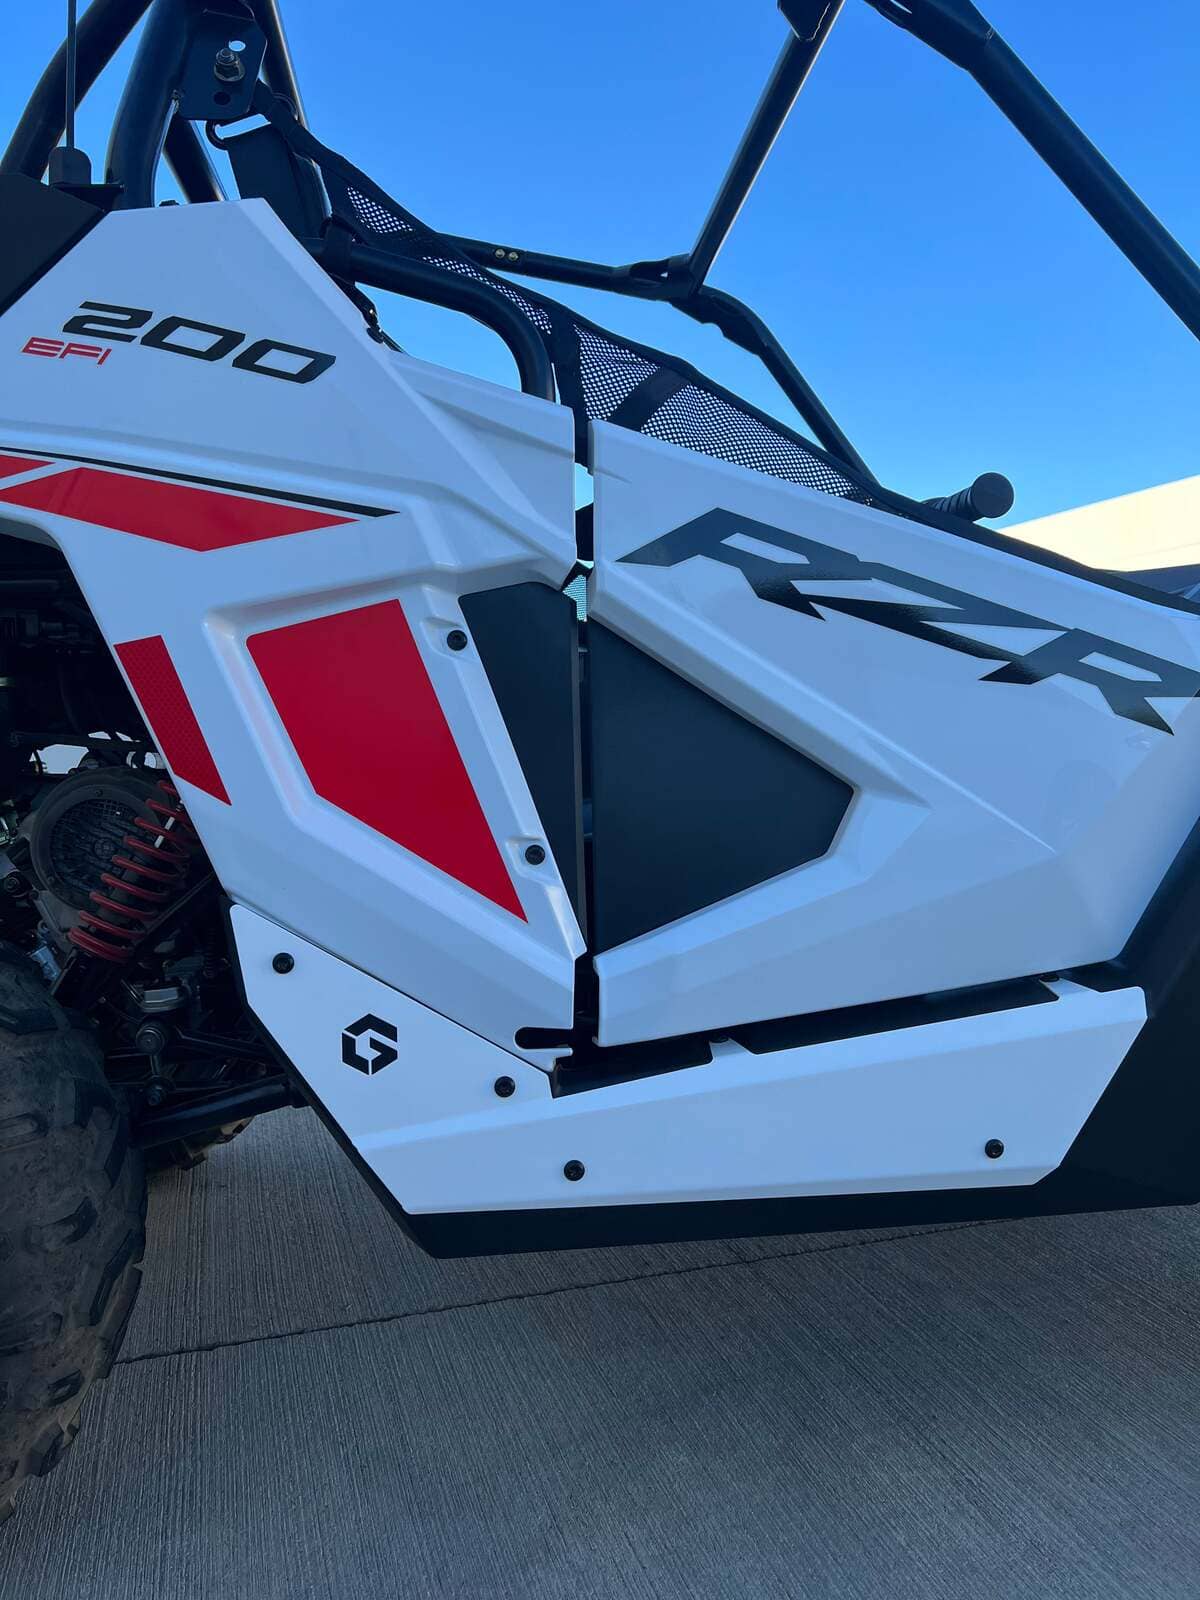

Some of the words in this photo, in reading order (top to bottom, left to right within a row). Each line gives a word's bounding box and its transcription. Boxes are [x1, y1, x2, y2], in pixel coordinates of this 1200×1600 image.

[21, 336, 112, 365] EFI
[62, 301, 337, 384] 200
[615, 507, 1200, 735] RZR
